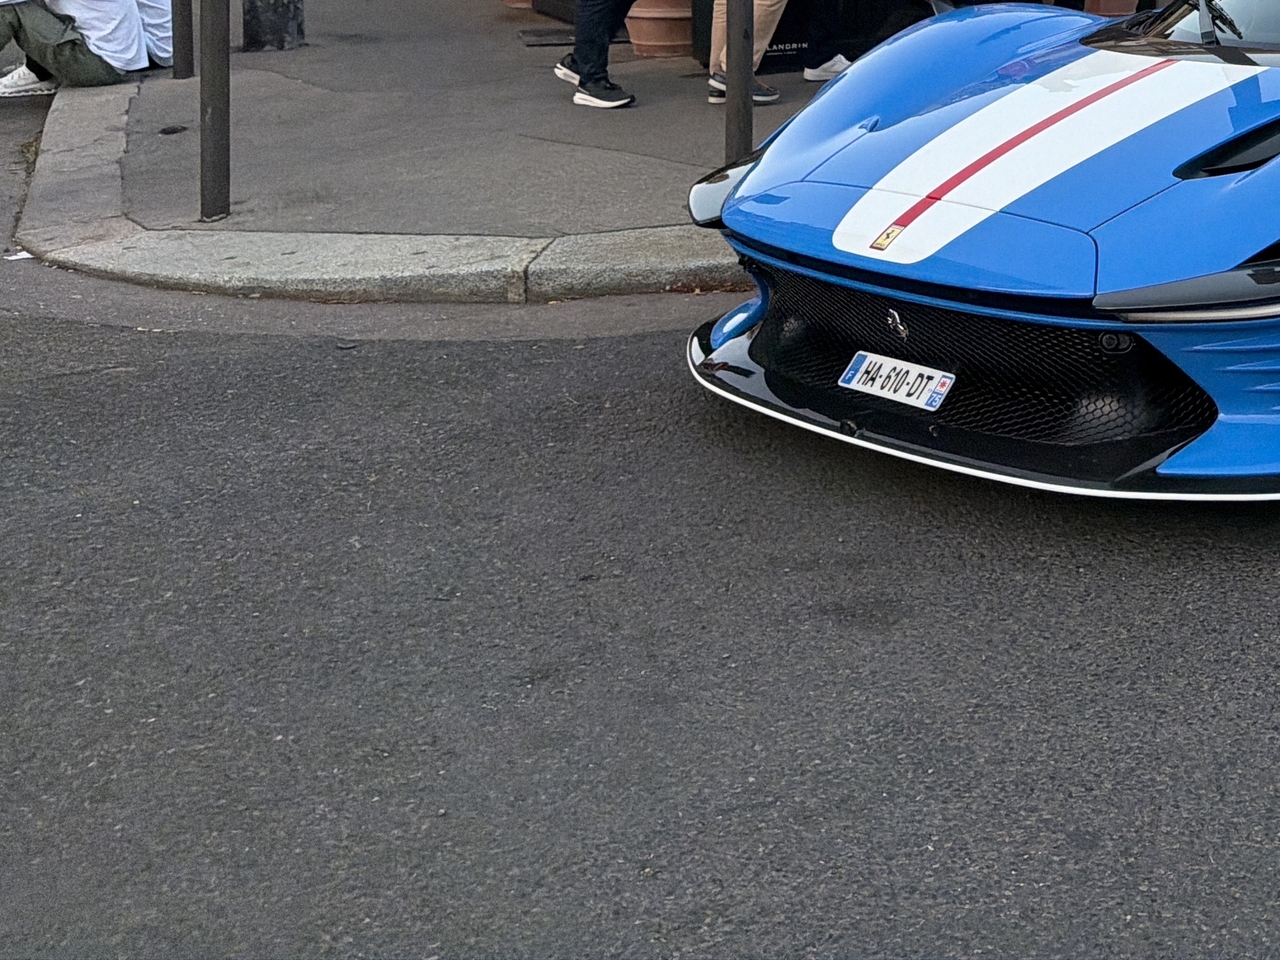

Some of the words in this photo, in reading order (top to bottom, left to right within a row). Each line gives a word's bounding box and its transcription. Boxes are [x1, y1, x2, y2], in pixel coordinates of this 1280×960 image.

[766, 42, 809, 52] LANDRIN
[845, 370, 855, 381] F
[857, 360, 935, 401] HA-610-DT
[927, 393, 942, 407] 75
